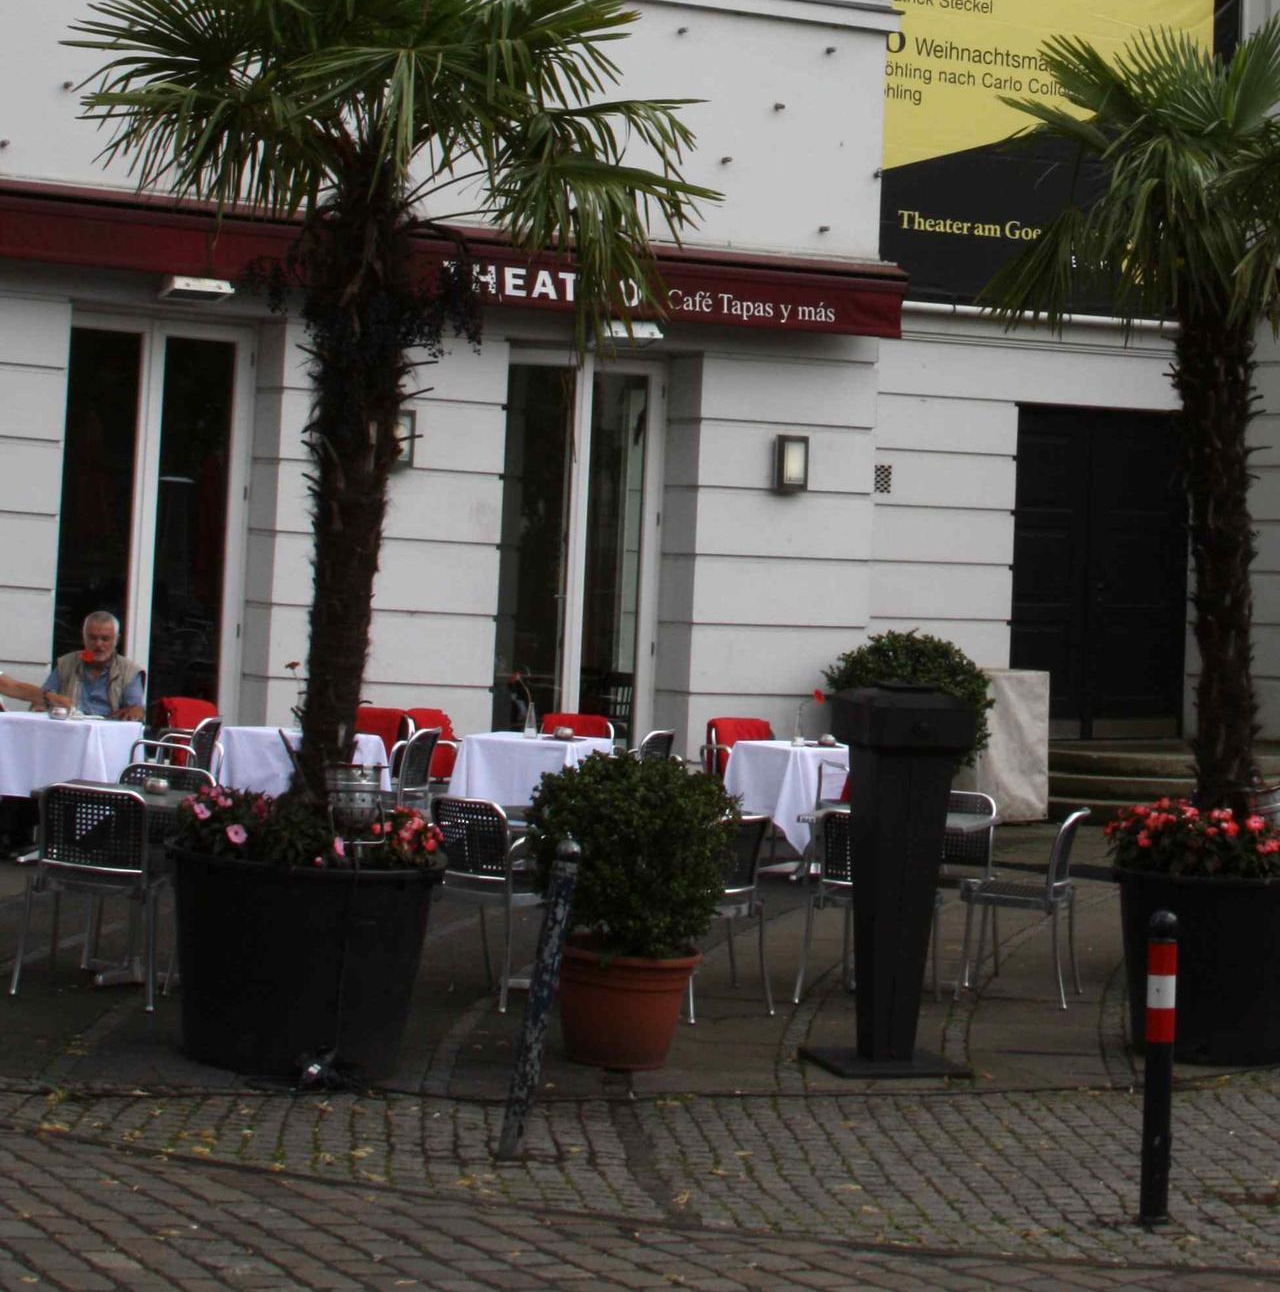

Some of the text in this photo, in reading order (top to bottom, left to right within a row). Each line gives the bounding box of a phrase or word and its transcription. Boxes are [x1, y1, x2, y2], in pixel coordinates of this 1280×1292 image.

[938, 69, 976, 87] nach
[981, 72, 1023, 93] Carlo
[898, 209, 972, 236] Theater
[973, 222, 1001, 238] am
[667, 289, 713, 313] Café
[718, 293, 774, 321] Tapas
[779, 303, 792, 323] y
[797, 302, 836, 323] más
